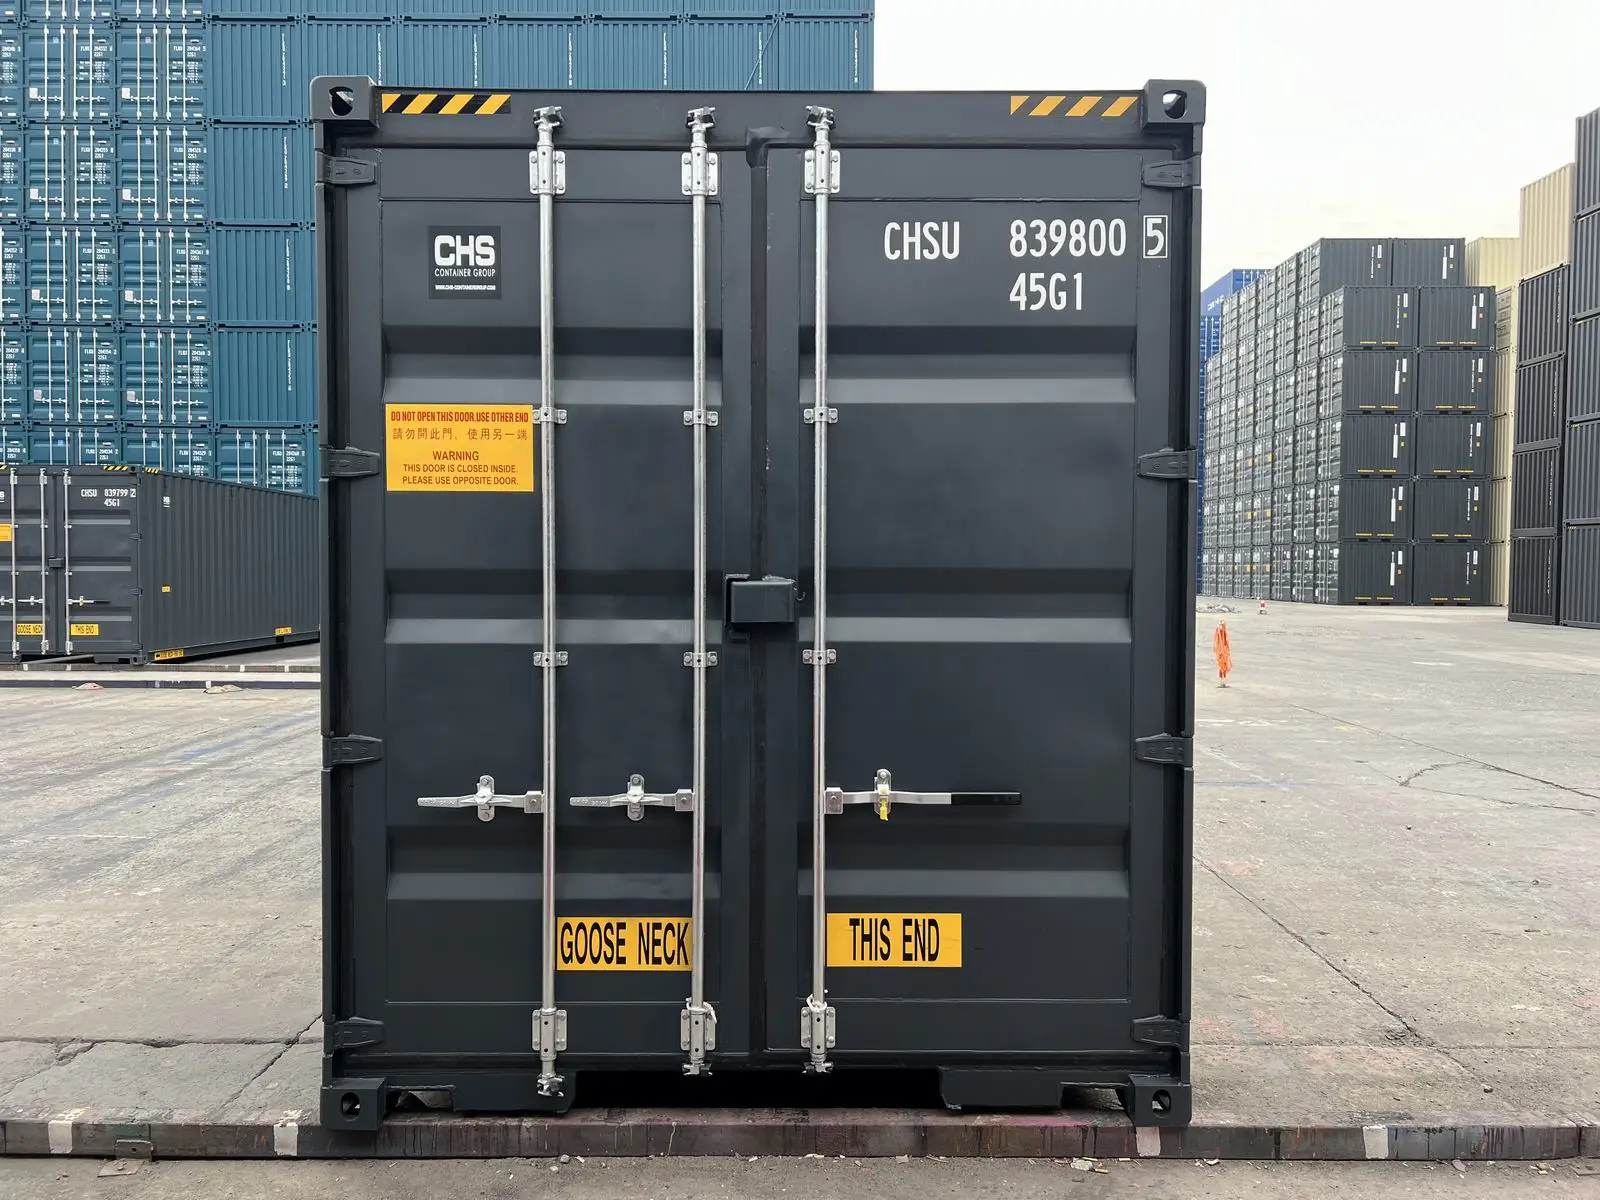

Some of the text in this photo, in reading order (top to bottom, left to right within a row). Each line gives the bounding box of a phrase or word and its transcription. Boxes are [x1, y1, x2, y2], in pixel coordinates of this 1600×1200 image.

[884, 217, 1166, 260] CHSU 839800 5
[434, 235, 495, 266] CHS
[434, 268, 495, 277] CONTAINER GROUP
[1010, 272, 1082, 311] 45G1
[391, 411, 400, 421] DO
[402, 411, 416, 422] NOT
[417, 411, 435, 422] OPEN
[437, 411, 453, 422] THIS
[491, 412, 514, 422] OTHER
[515, 412, 529, 422] END
[433, 451, 479, 461] WARNING
[403, 464, 518, 473] THIS DOOR IS CLOSED INSIDE.
[403, 476, 518, 485] PLEASE USE OPPOSITE DOOR.
[81, 489, 98, 498] CHSU
[104, 489, 128, 497] 839799
[104, 498, 120, 507] 45G1
[560, 922, 689, 965] GOOSE NECK
[849, 918, 940, 962] THIS END
